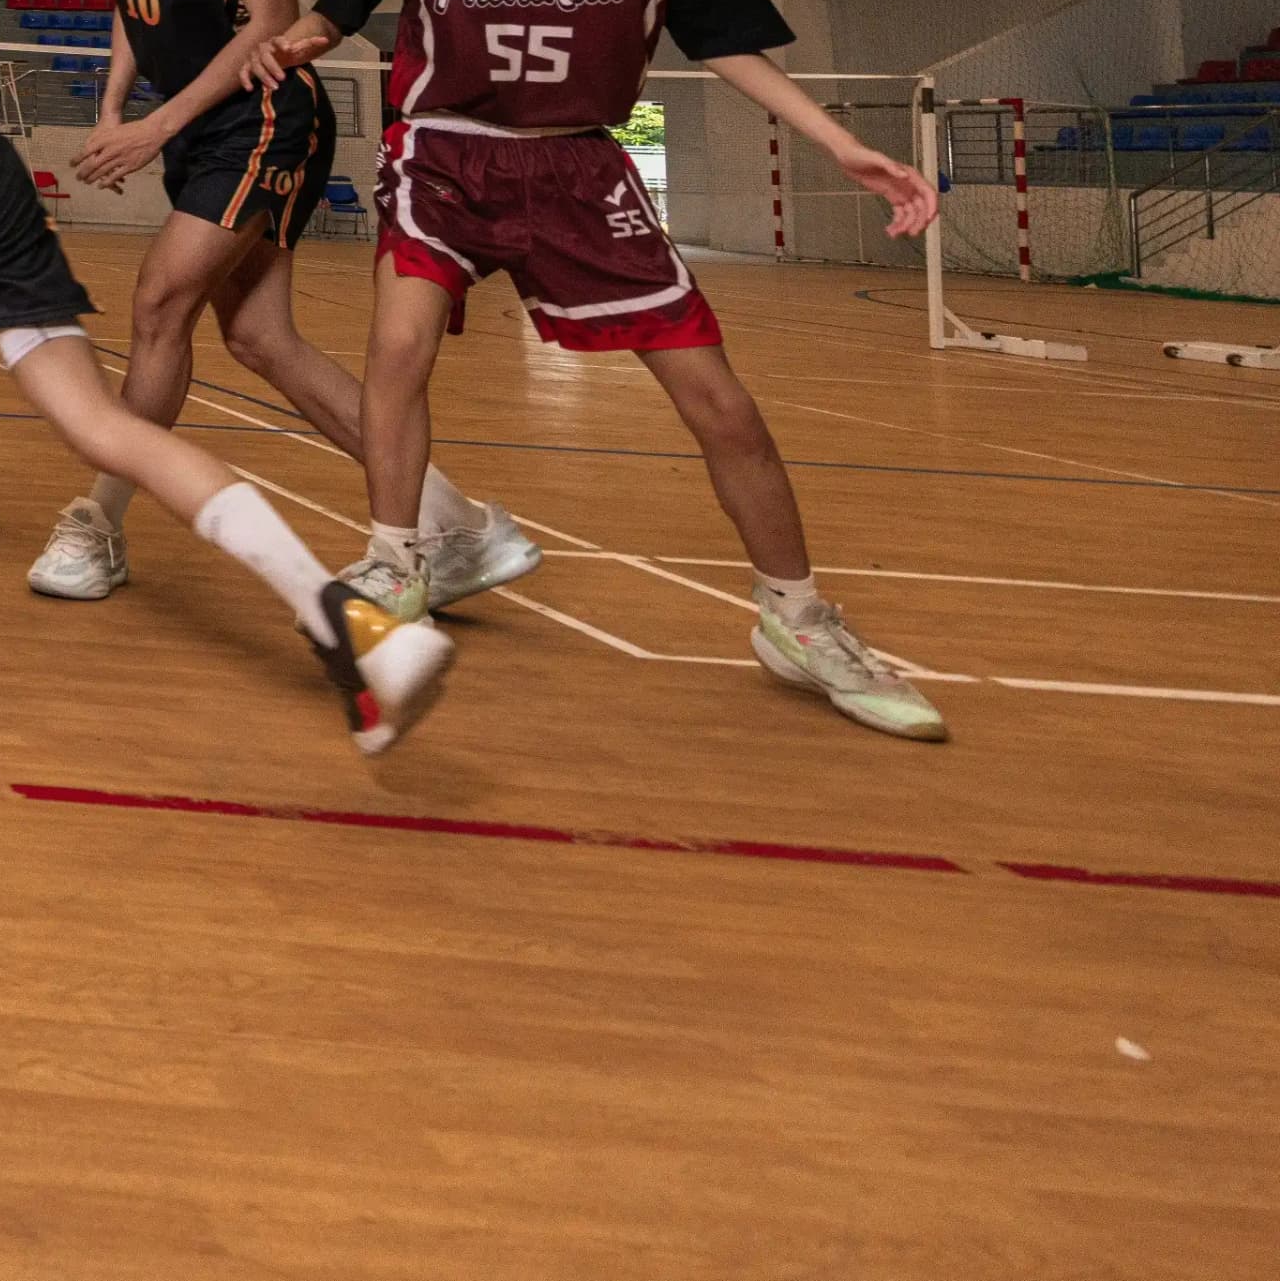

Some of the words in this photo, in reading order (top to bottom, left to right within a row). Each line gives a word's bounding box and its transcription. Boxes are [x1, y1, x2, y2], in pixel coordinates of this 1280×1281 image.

[485, 24, 574, 83] 55
[259, 166, 292, 195] 10
[606, 209, 651, 238] 55
